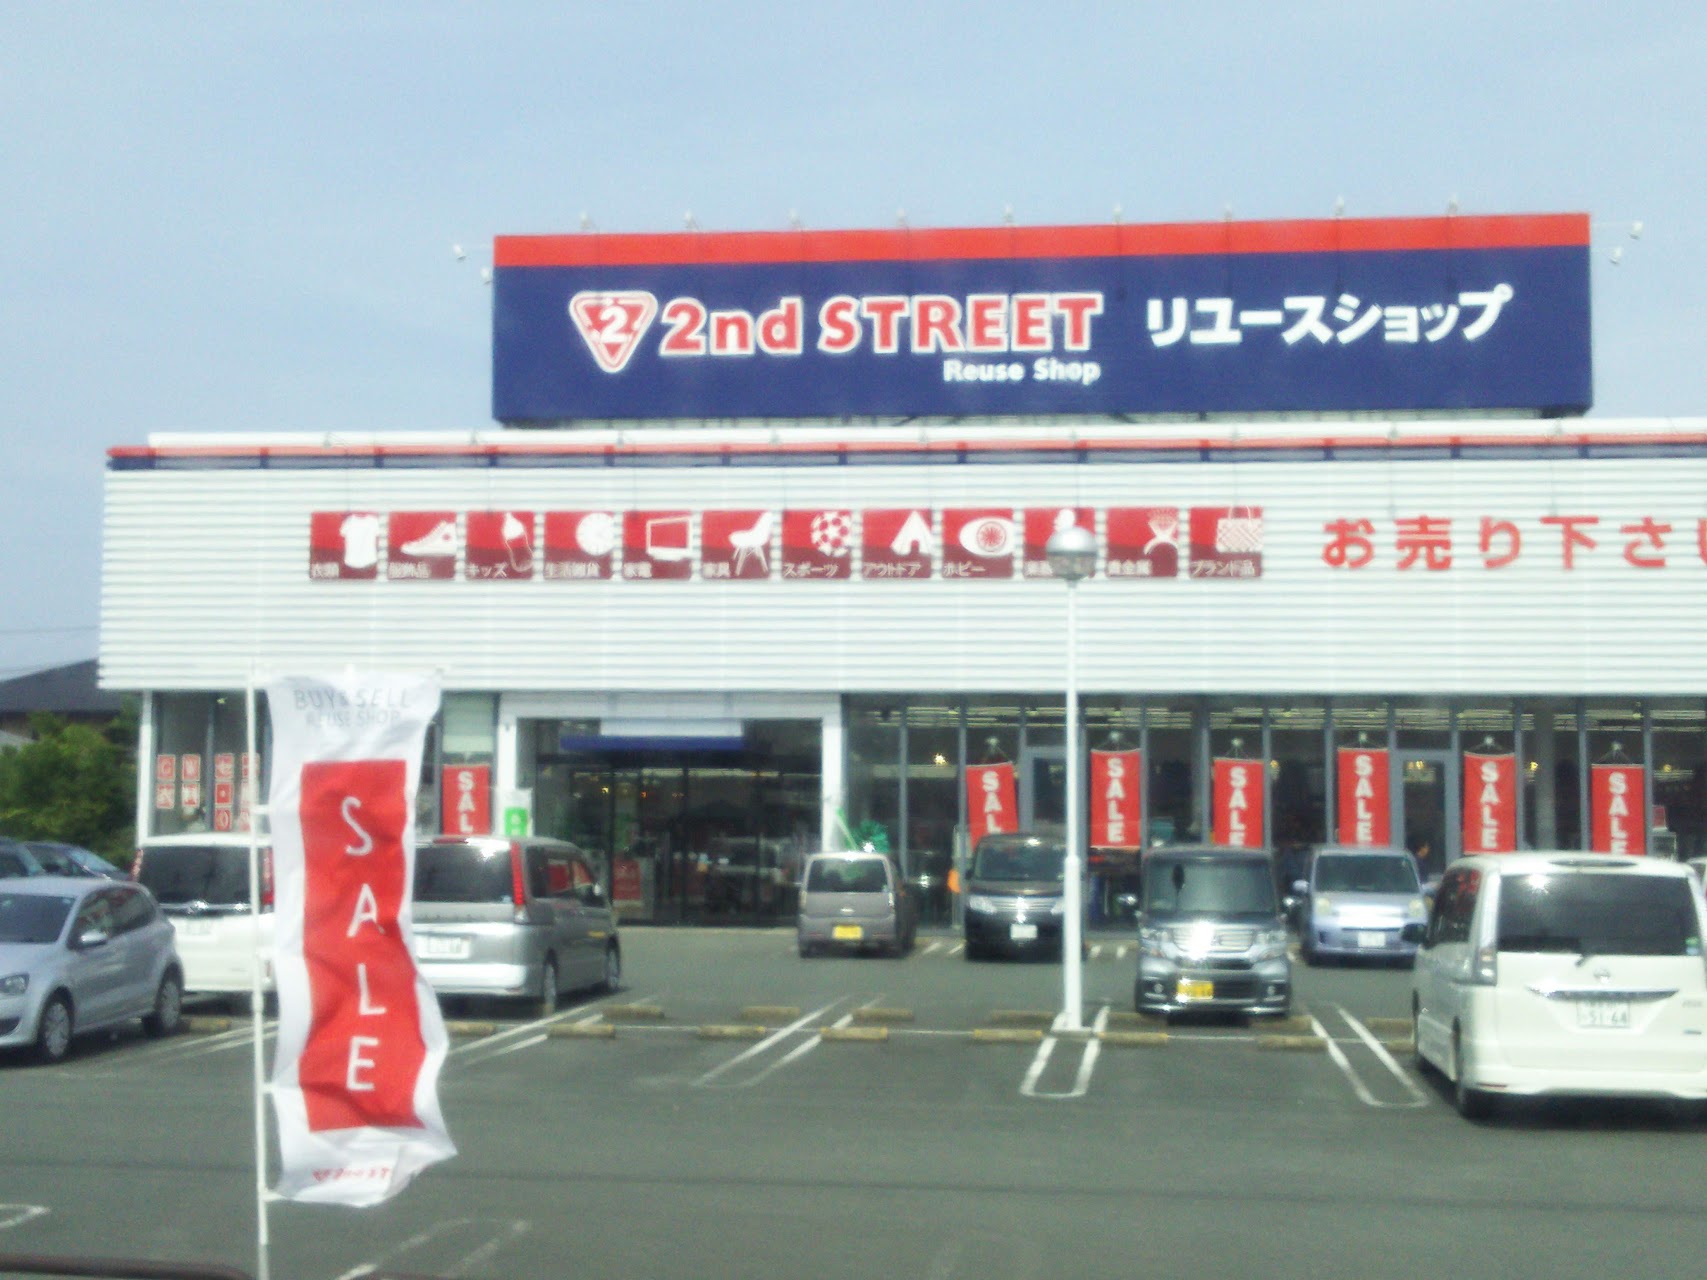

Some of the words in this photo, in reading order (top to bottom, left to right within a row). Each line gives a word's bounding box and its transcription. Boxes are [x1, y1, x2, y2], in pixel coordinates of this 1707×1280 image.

[660, 297, 802, 355] 2nd
[818, 293, 1103, 353] STREET
[1146, 283, 1514, 347] リユースショップ
[943, 358, 1025, 382] Reuse
[1033, 356, 1101, 386] Shop
[466, 562, 508, 578] キッズ
[783, 561, 839, 577] スポーツ
[943, 561, 986, 576] ホビー
[457, 771, 476, 834] SAL
[982, 771, 1002, 833] SAL
[1106, 758, 1125, 843] SALE
[1228, 766, 1247, 846] SALE
[1354, 755, 1374, 845] SALE
[1480, 762, 1501, 849] SALE
[341, 796, 386, 1092] SALE
